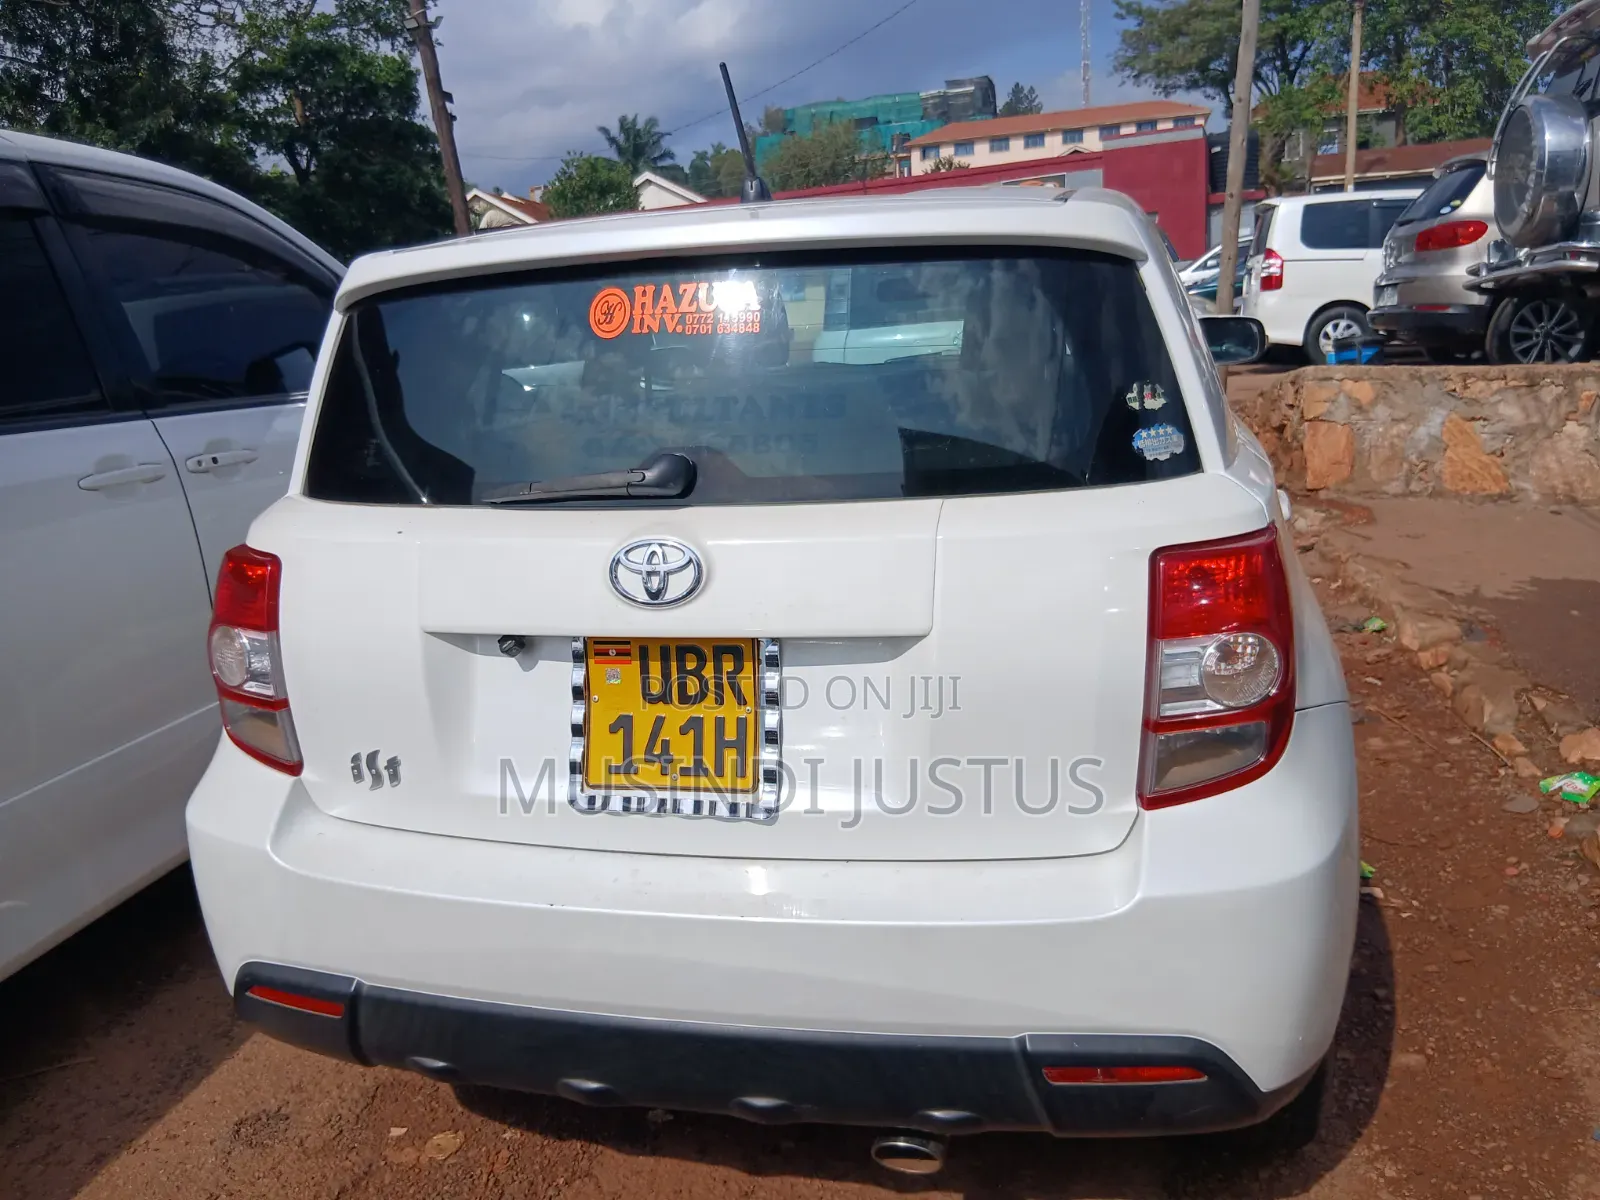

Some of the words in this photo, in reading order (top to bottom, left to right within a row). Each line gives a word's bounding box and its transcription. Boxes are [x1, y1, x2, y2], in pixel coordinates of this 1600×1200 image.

[632, 280, 760, 314] HAZUA
[631, 313, 683, 334] INV.
[685, 313, 714, 325] 0772
[685, 323, 713, 335] 0701
[717, 322, 760, 334] 634848
[638, 645, 748, 706] UBR
[608, 713, 748, 778] 141H
